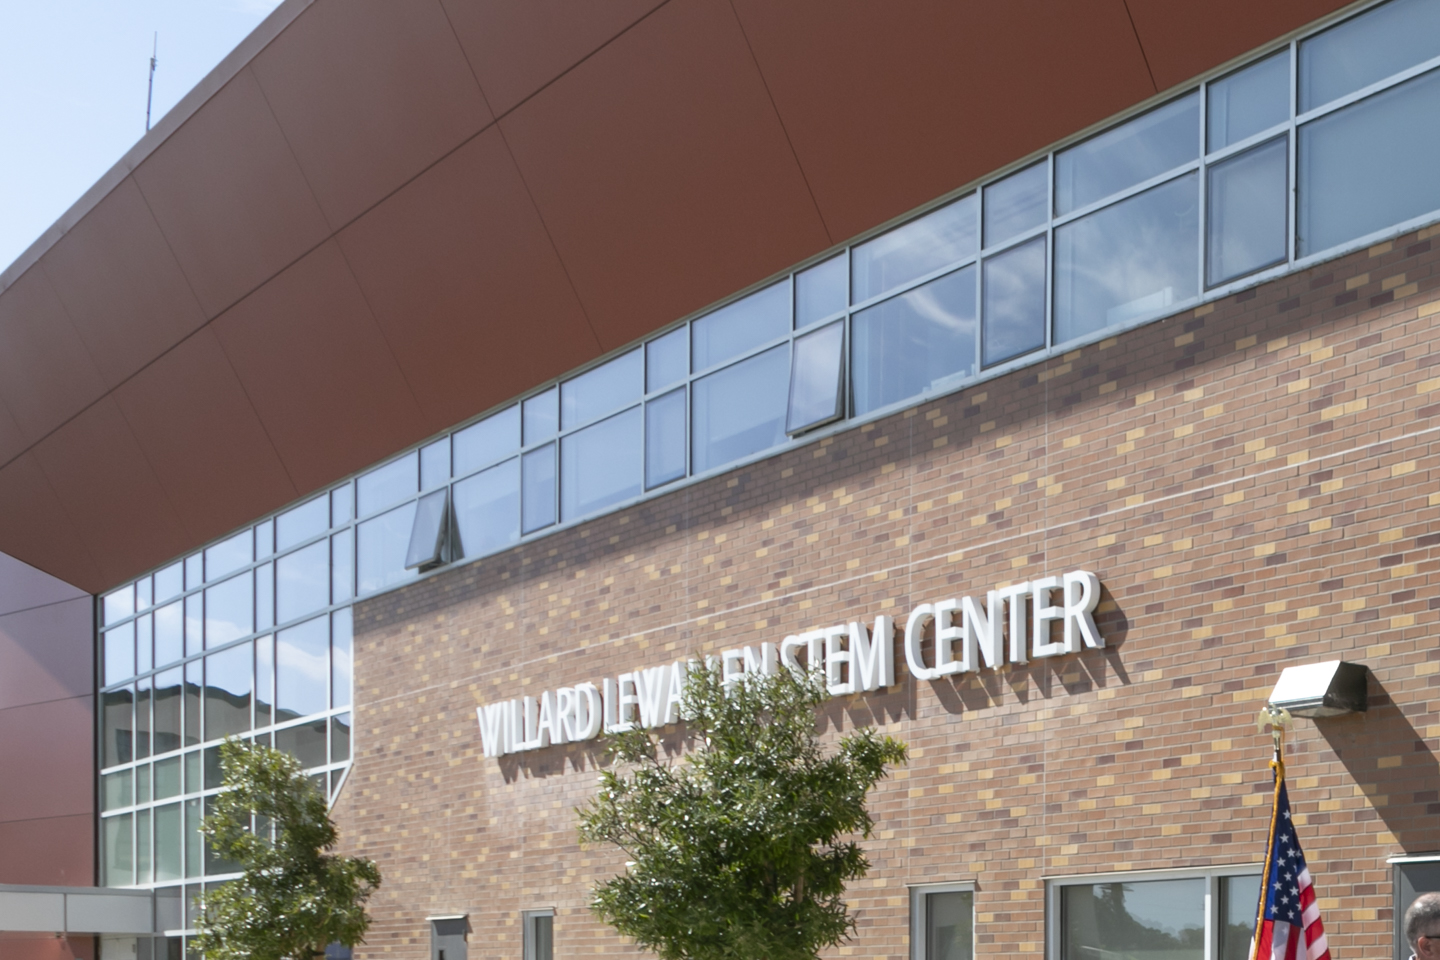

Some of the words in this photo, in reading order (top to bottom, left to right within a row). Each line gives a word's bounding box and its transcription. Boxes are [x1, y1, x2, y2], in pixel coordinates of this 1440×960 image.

[476, 682, 602, 758] WILLARD
[603, 643, 777, 734] LEWAEN
[904, 570, 1105, 680] CENTER
